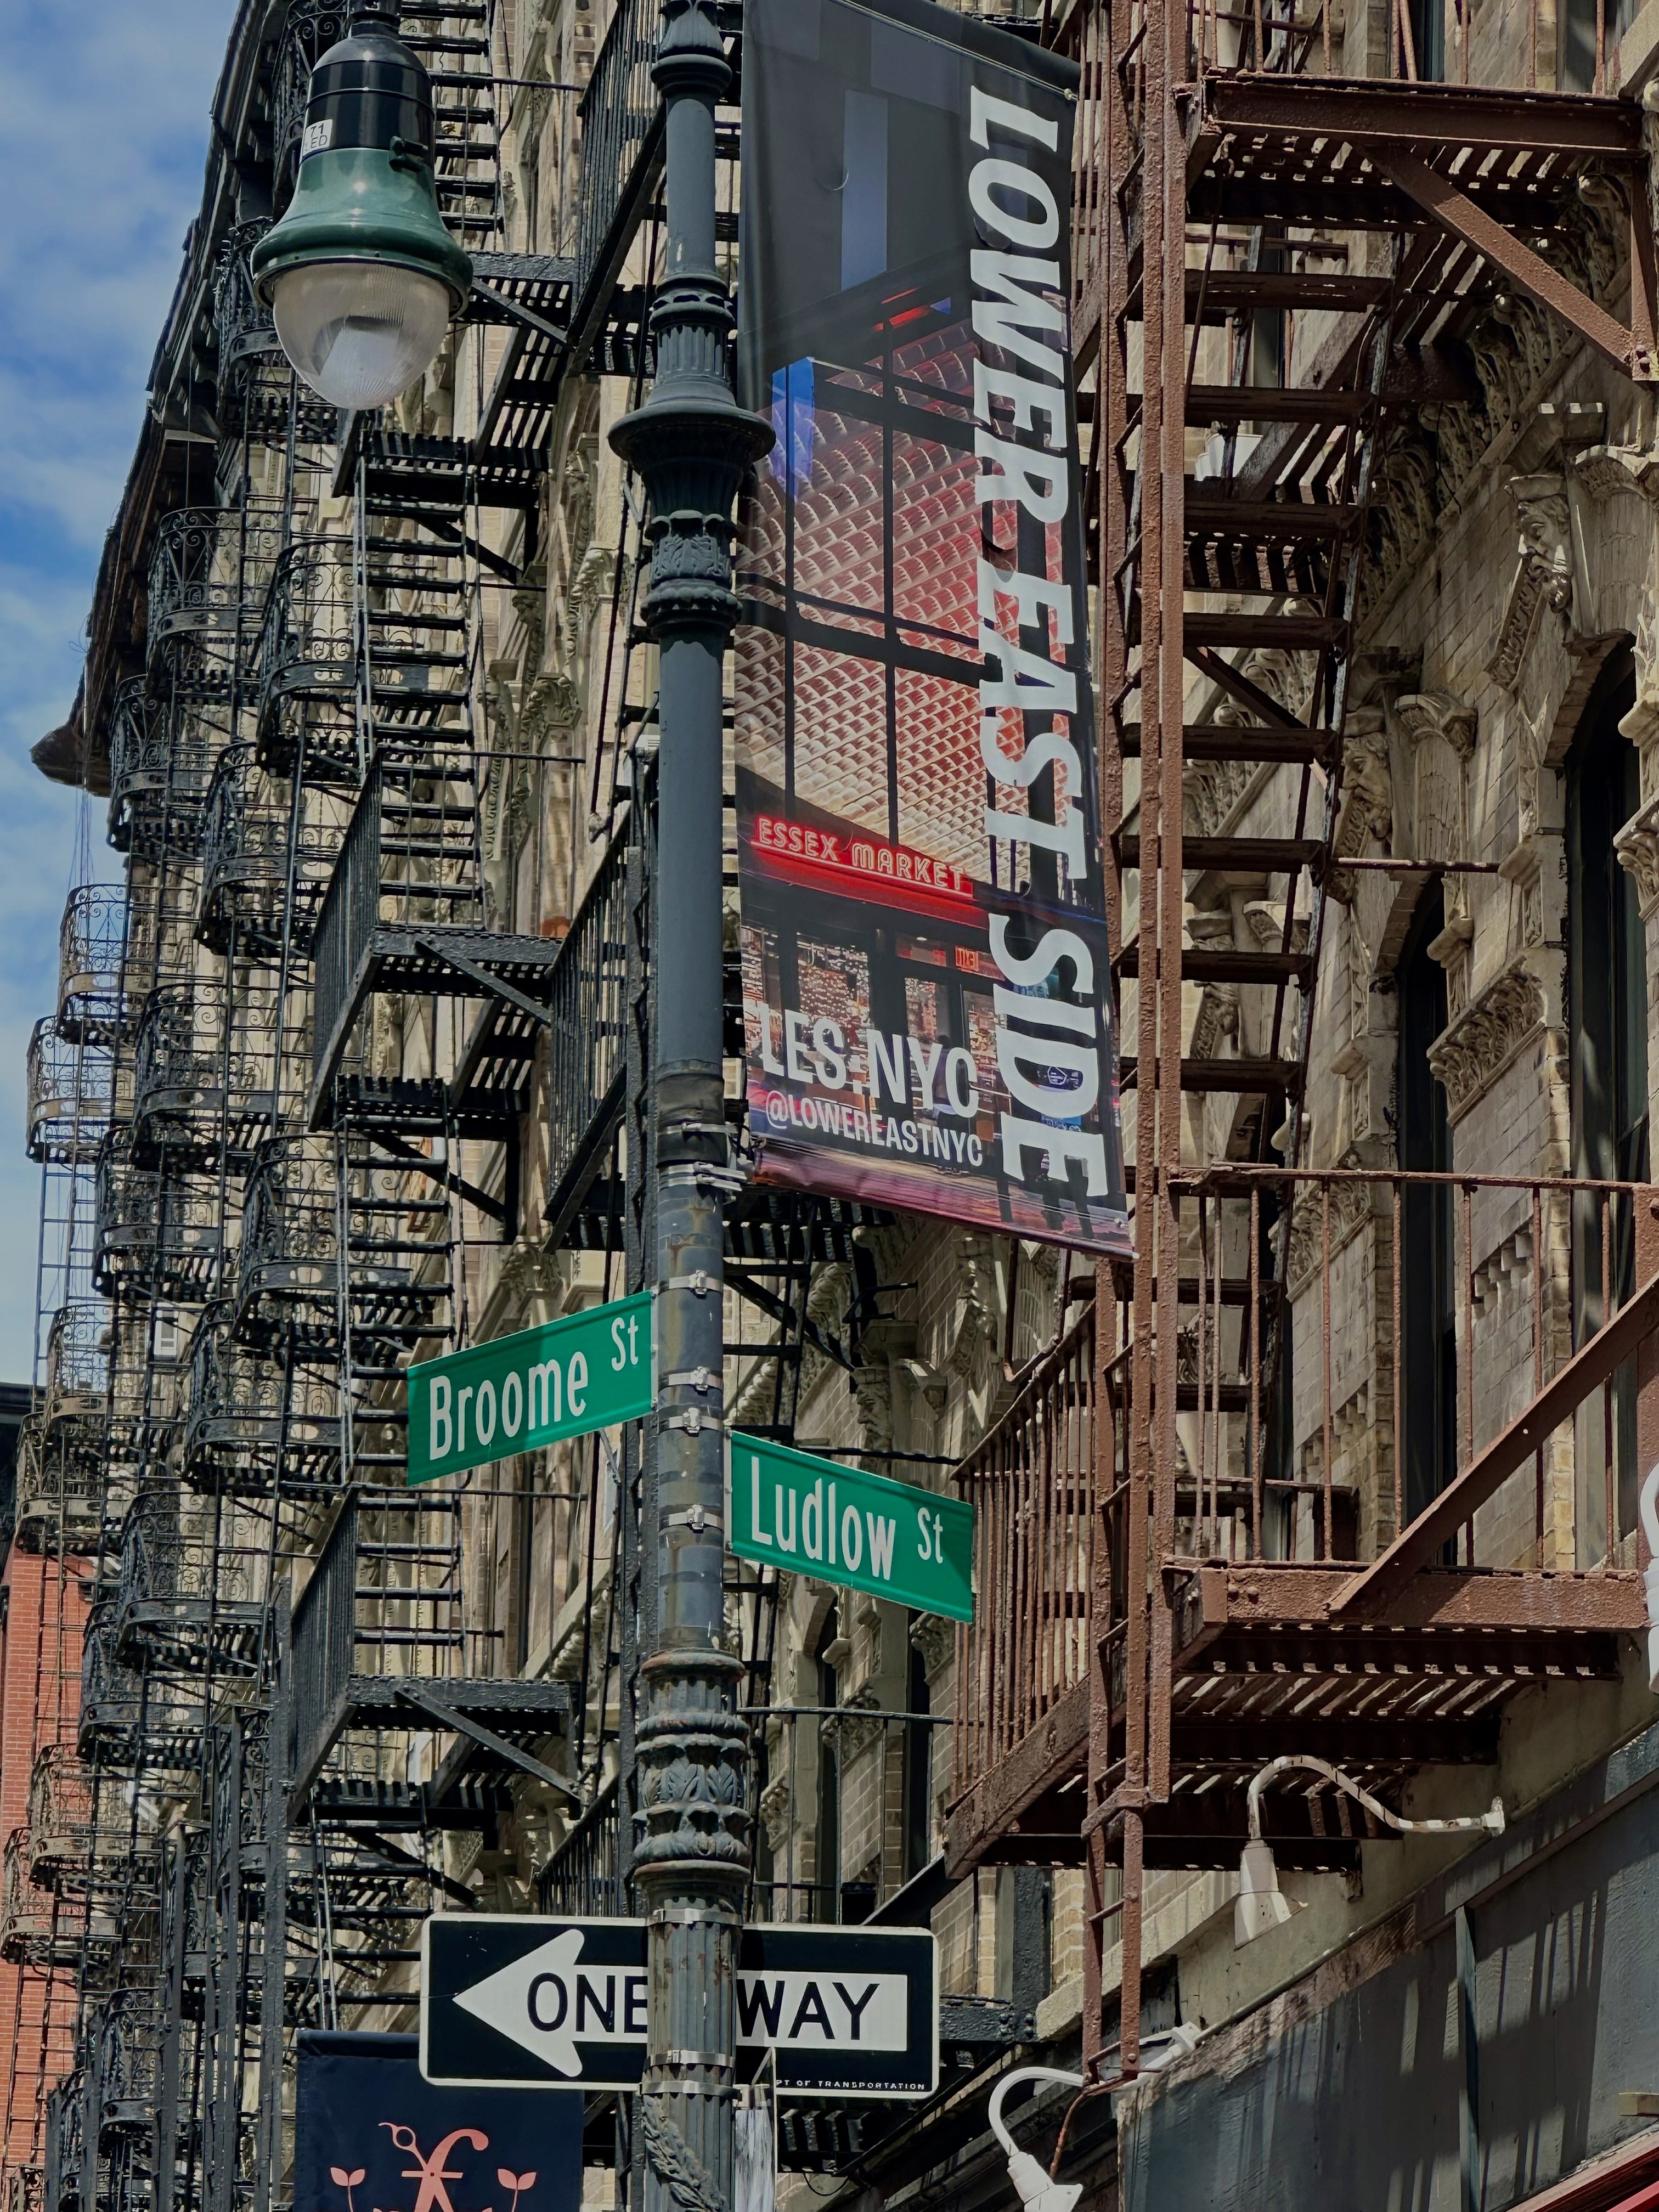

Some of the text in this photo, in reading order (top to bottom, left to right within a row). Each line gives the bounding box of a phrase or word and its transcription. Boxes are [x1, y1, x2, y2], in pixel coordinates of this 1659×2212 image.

[310, 123, 324, 138] 71
[968, 84, 1110, 1198] LOWER EAST SIDE
[758, 817, 966, 891] ESSEX MARKET
[759, 1002, 979, 1119] LES.NYC
[766, 1090, 983, 1167] @LOWEREASTNYC
[429, 1317, 639, 1460] Broome St
[751, 1456, 944, 1581] Ludlow St
[527, 1973, 879, 2040] ONE WAY
[819, 2080, 924, 2090] TRANSPORTATION
